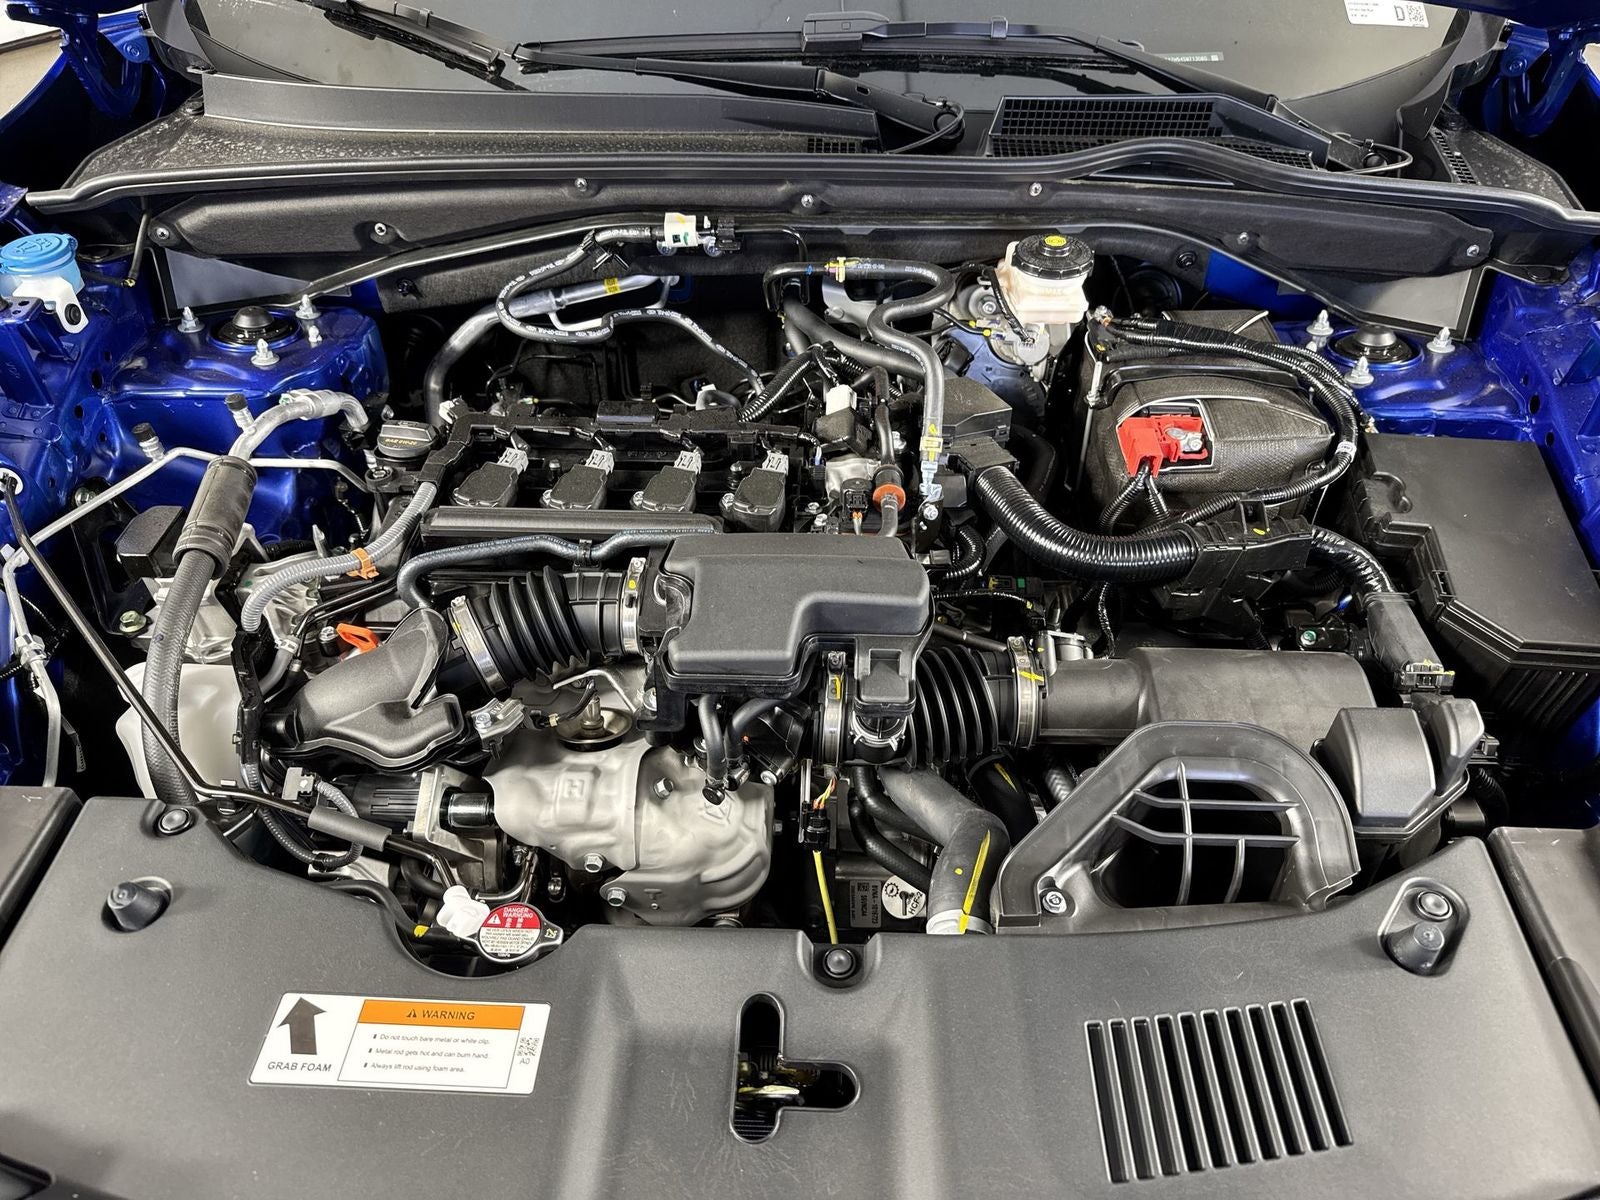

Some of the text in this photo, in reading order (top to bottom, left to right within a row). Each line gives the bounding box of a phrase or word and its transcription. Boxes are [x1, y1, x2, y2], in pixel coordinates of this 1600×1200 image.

[1394, 6, 1405, 21] D
[908, 891, 923, 915] HCF-2
[422, 1009, 475, 1020] WARNING
[380, 1033, 390, 1041] Do
[267, 1061, 332, 1072] GRAB FOAM
[371, 1062, 393, 1070] Always
[414, 1064, 431, 1072] using
